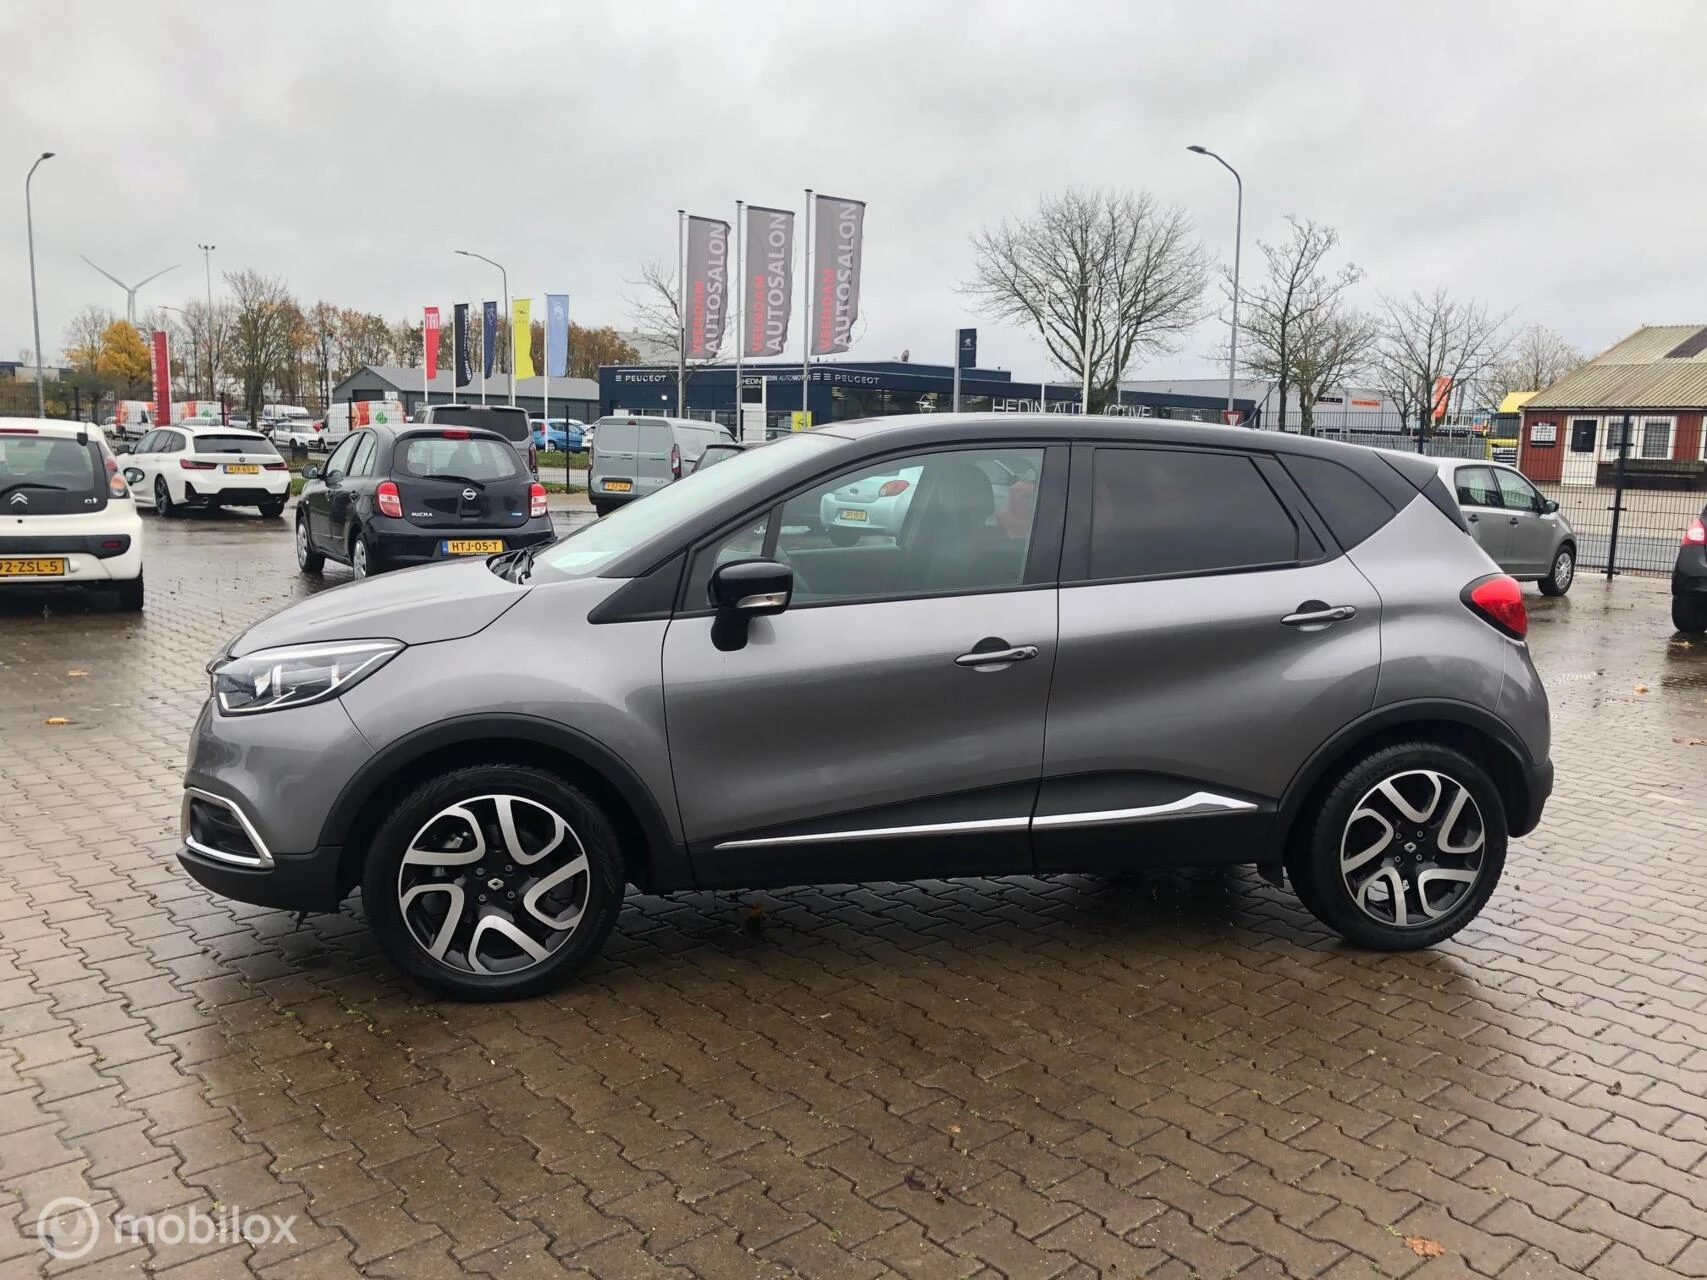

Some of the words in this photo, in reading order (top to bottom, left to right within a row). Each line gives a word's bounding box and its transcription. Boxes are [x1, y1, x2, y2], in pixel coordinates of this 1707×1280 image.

[705, 223, 726, 352] AUTOSALON
[752, 274, 766, 352] VEENDAM
[766, 213, 787, 350] AUTOSALON
[820, 268, 835, 350] VEENDAM
[834, 203, 858, 347] AUTOSALON
[691, 280, 705, 354] VEENDAM
[625, 374, 667, 382] PEUGEOT
[835, 374, 880, 384] PEUGEOT
[452, 541, 498, 551] HTJ-05-T
